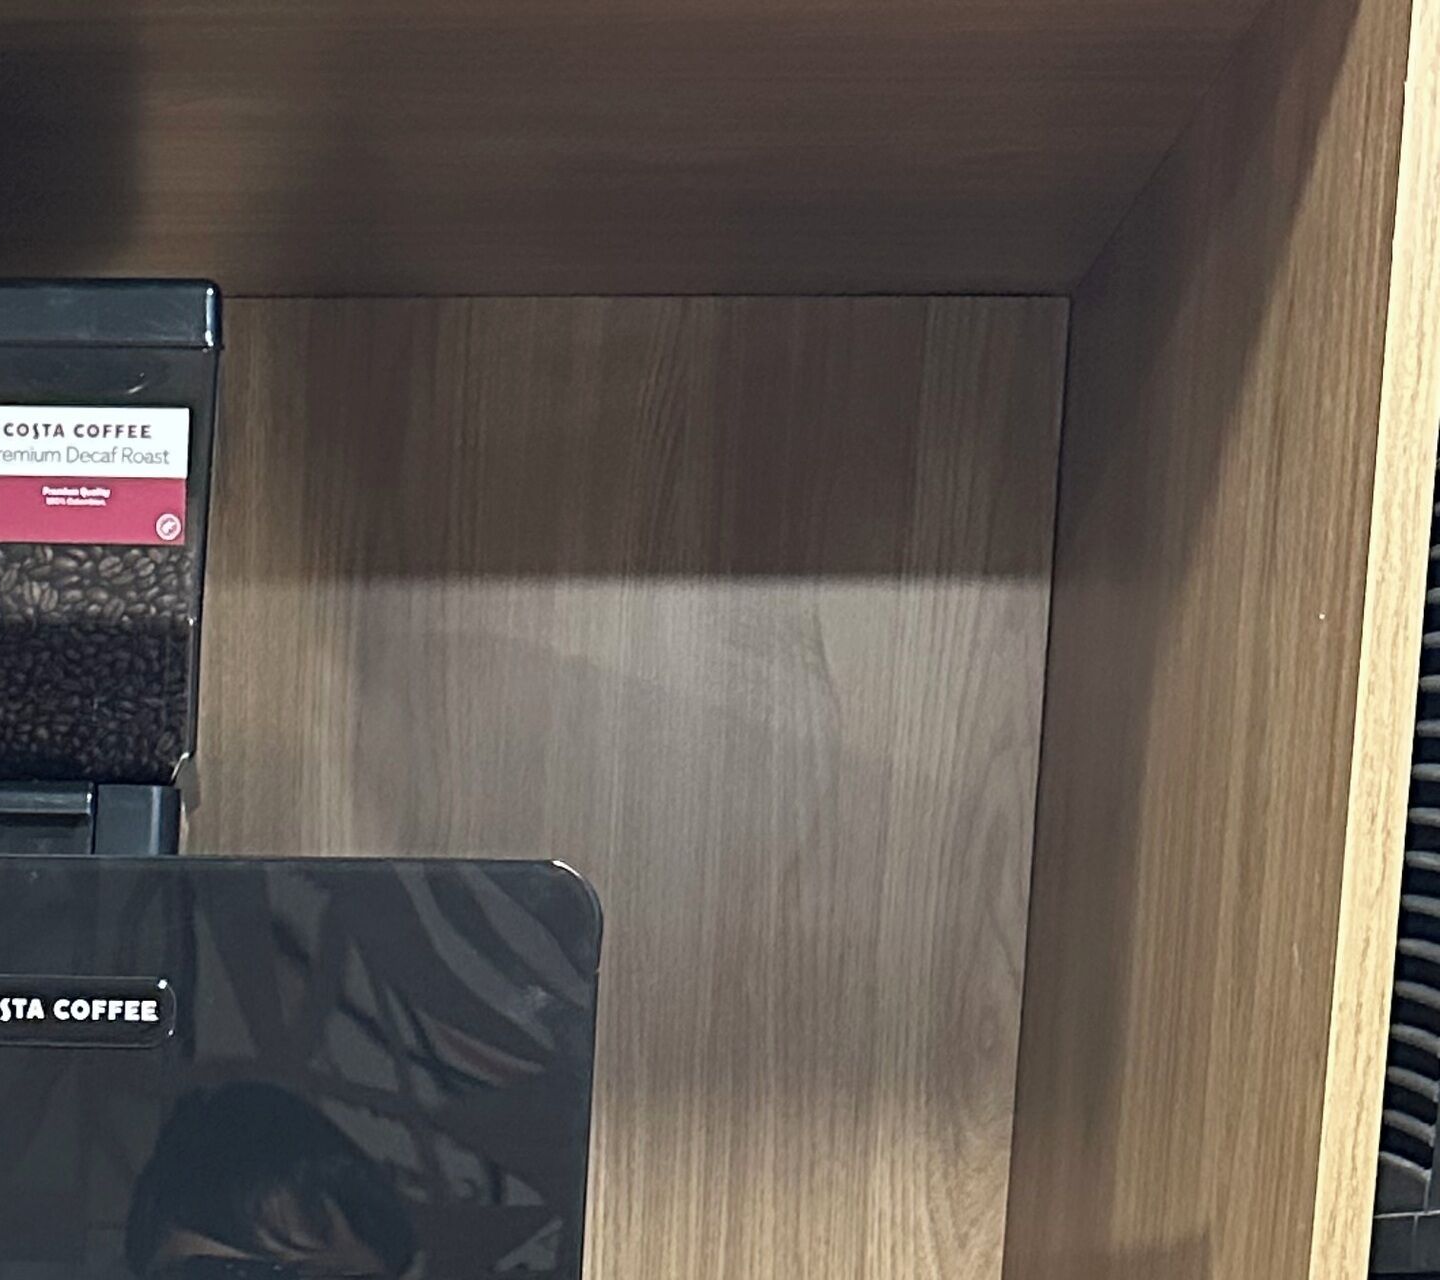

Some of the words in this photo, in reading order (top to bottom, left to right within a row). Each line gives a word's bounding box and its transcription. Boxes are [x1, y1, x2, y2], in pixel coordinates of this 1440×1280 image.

[3, 422, 65, 439] COSTA
[74, 423, 152, 439] COFFEE
[66, 446, 118, 464] Decaf
[121, 447, 170, 465] Roast
[53, 998, 159, 1022] COFFEE
